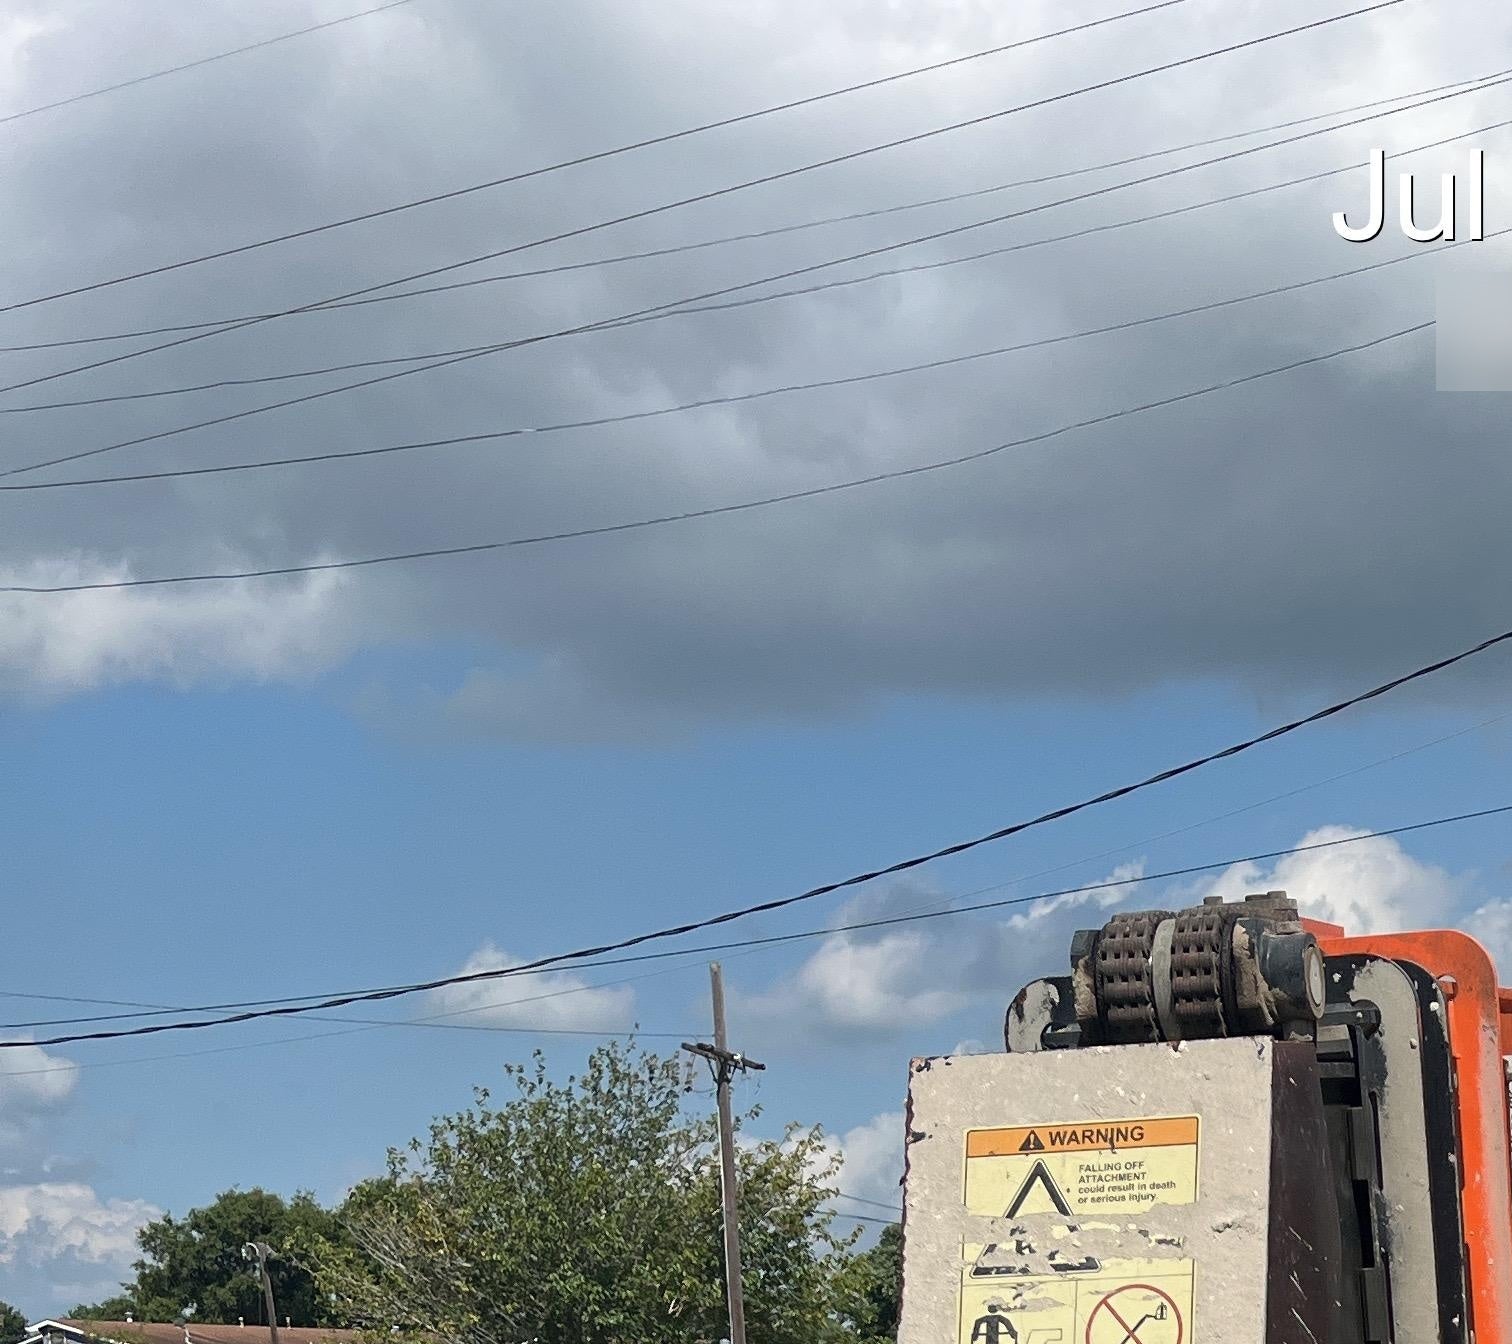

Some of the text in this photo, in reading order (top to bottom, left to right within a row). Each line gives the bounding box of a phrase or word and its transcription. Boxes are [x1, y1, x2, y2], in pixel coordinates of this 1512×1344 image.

[1048, 1125, 1145, 1147] WARNING
[1078, 1160, 1145, 1173] FALLING OFF
[1078, 1171, 1147, 1184] ATTACHMENT
[1078, 1180, 1177, 1194] could result in death
[1077, 1196, 1088, 1204] or
[1090, 1193, 1127, 1203] serious
